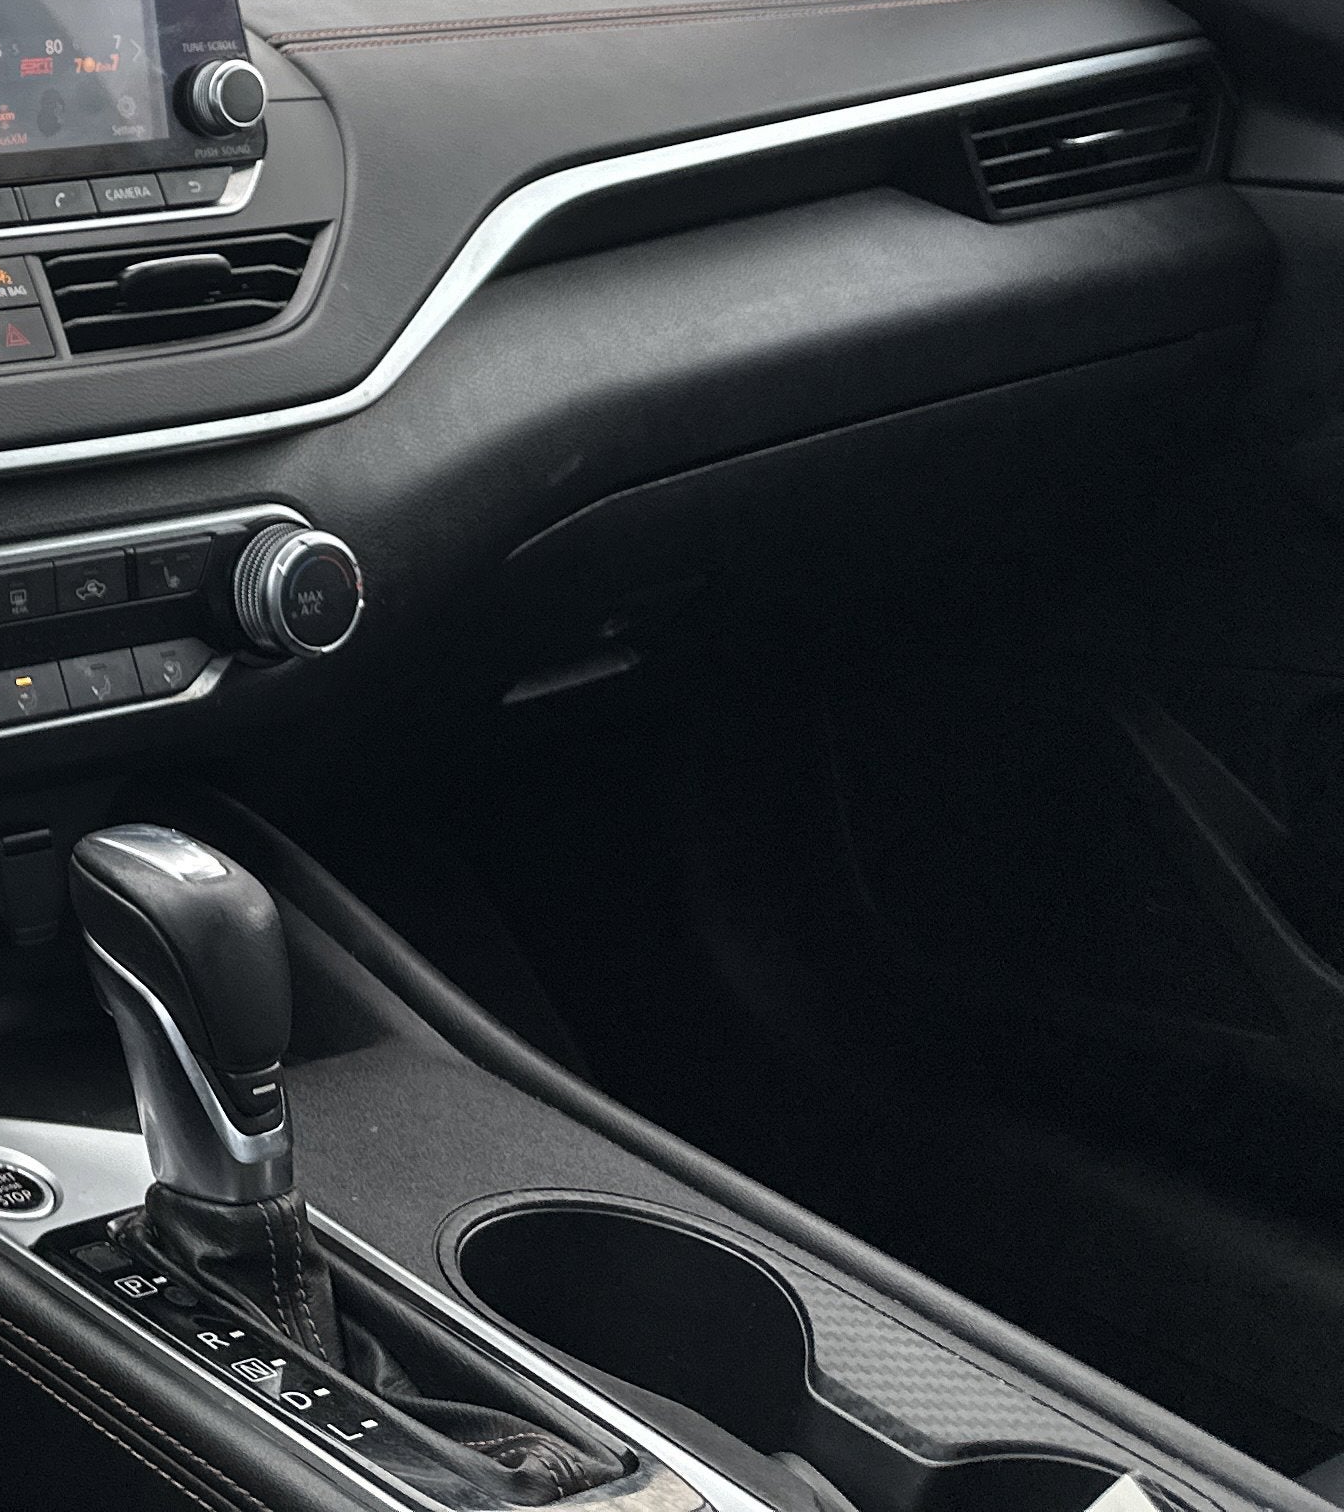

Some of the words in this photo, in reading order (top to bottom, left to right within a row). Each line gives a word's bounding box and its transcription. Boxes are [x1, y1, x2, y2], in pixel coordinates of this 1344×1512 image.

[45, 39, 63, 55] 80
[113, 34, 121, 49] 7
[105, 185, 151, 201] CAMERA
[7, 285, 28, 297] BAG
[297, 590, 324, 605] MAX
[300, 601, 323, 616] A/C
[124, 1278, 144, 1294] P
[197, 1331, 230, 1350] R
[280, 1391, 312, 1410] D
[327, 1423, 364, 1441] L
